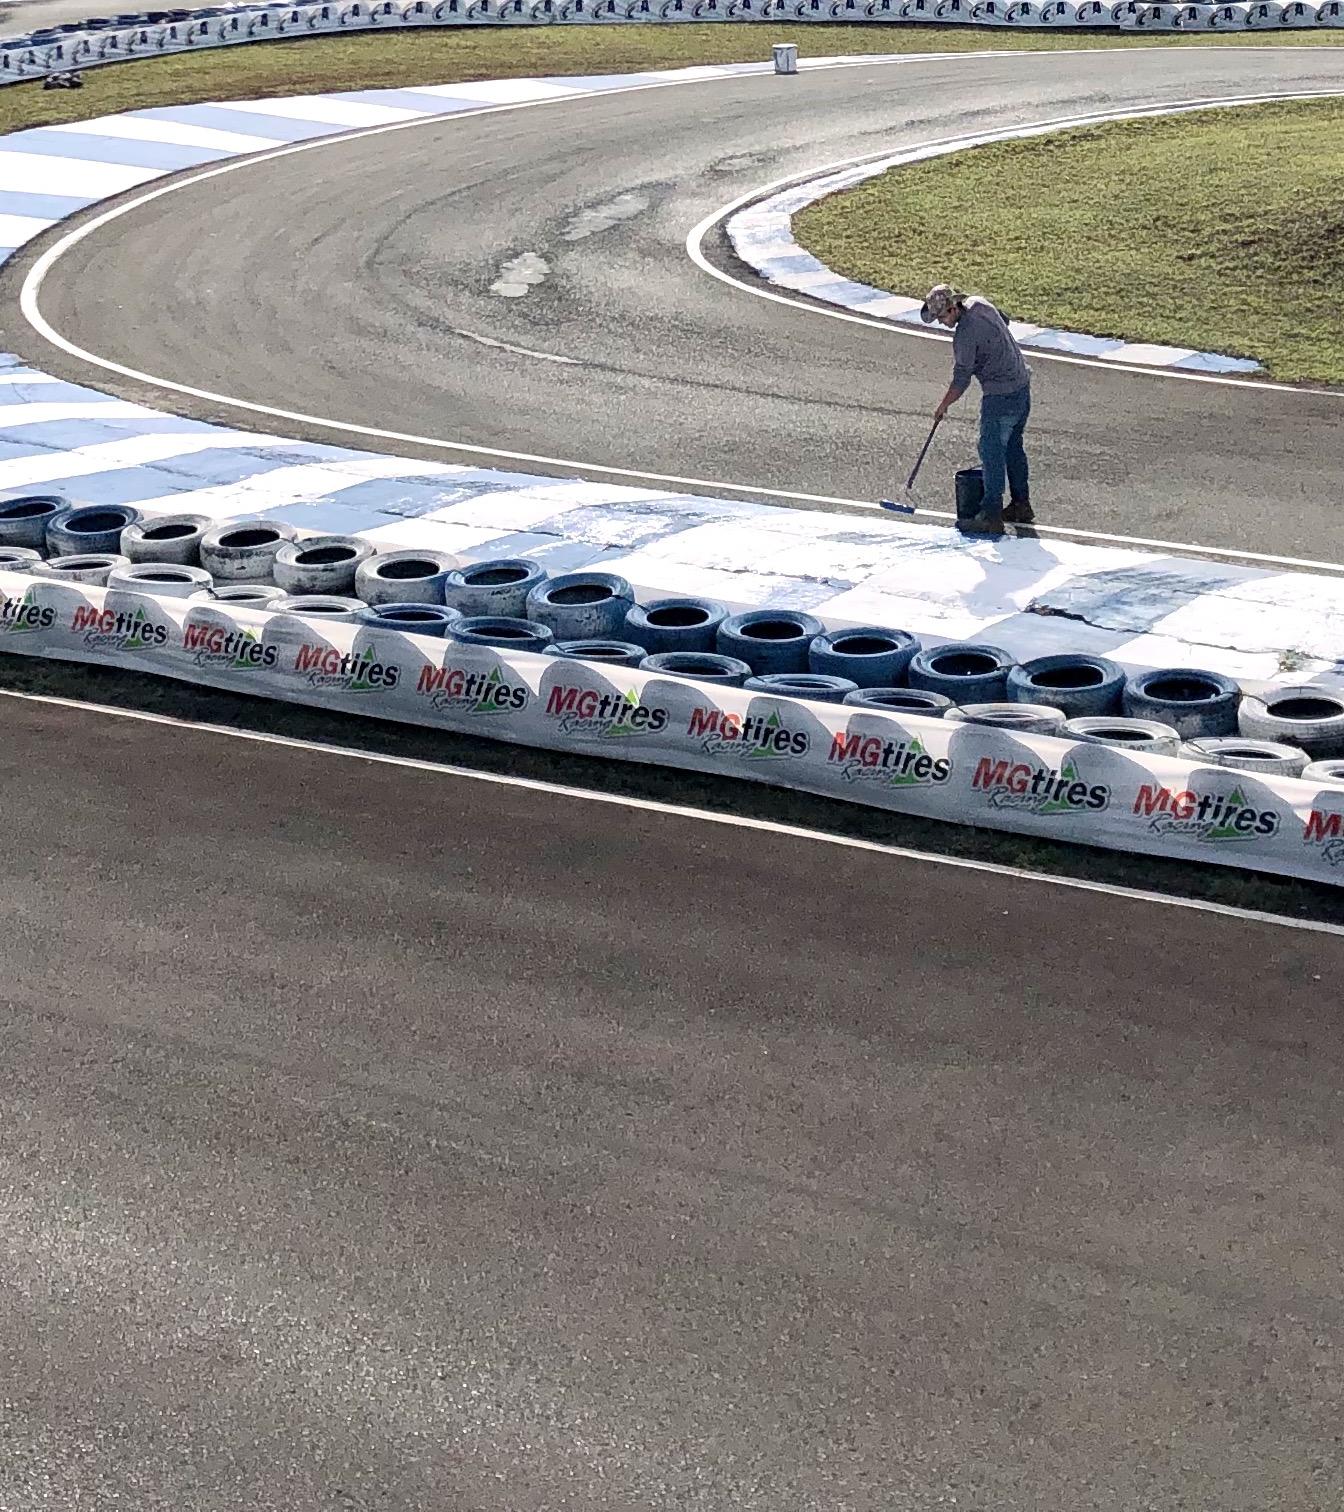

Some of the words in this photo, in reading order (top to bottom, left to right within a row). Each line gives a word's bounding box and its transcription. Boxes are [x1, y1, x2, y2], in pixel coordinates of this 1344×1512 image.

[72, 605, 167, 645] MGtires
[184, 624, 277, 666] MGtires
[295, 644, 398, 687] MGtires
[418, 665, 526, 710] MGtires
[546, 686, 668, 730] MGtires
[688, 707, 809, 754] MGtires
[830, 732, 952, 784] MGtires
[973, 757, 1108, 810] MGtires
[1133, 785, 1278, 835] MGtires
